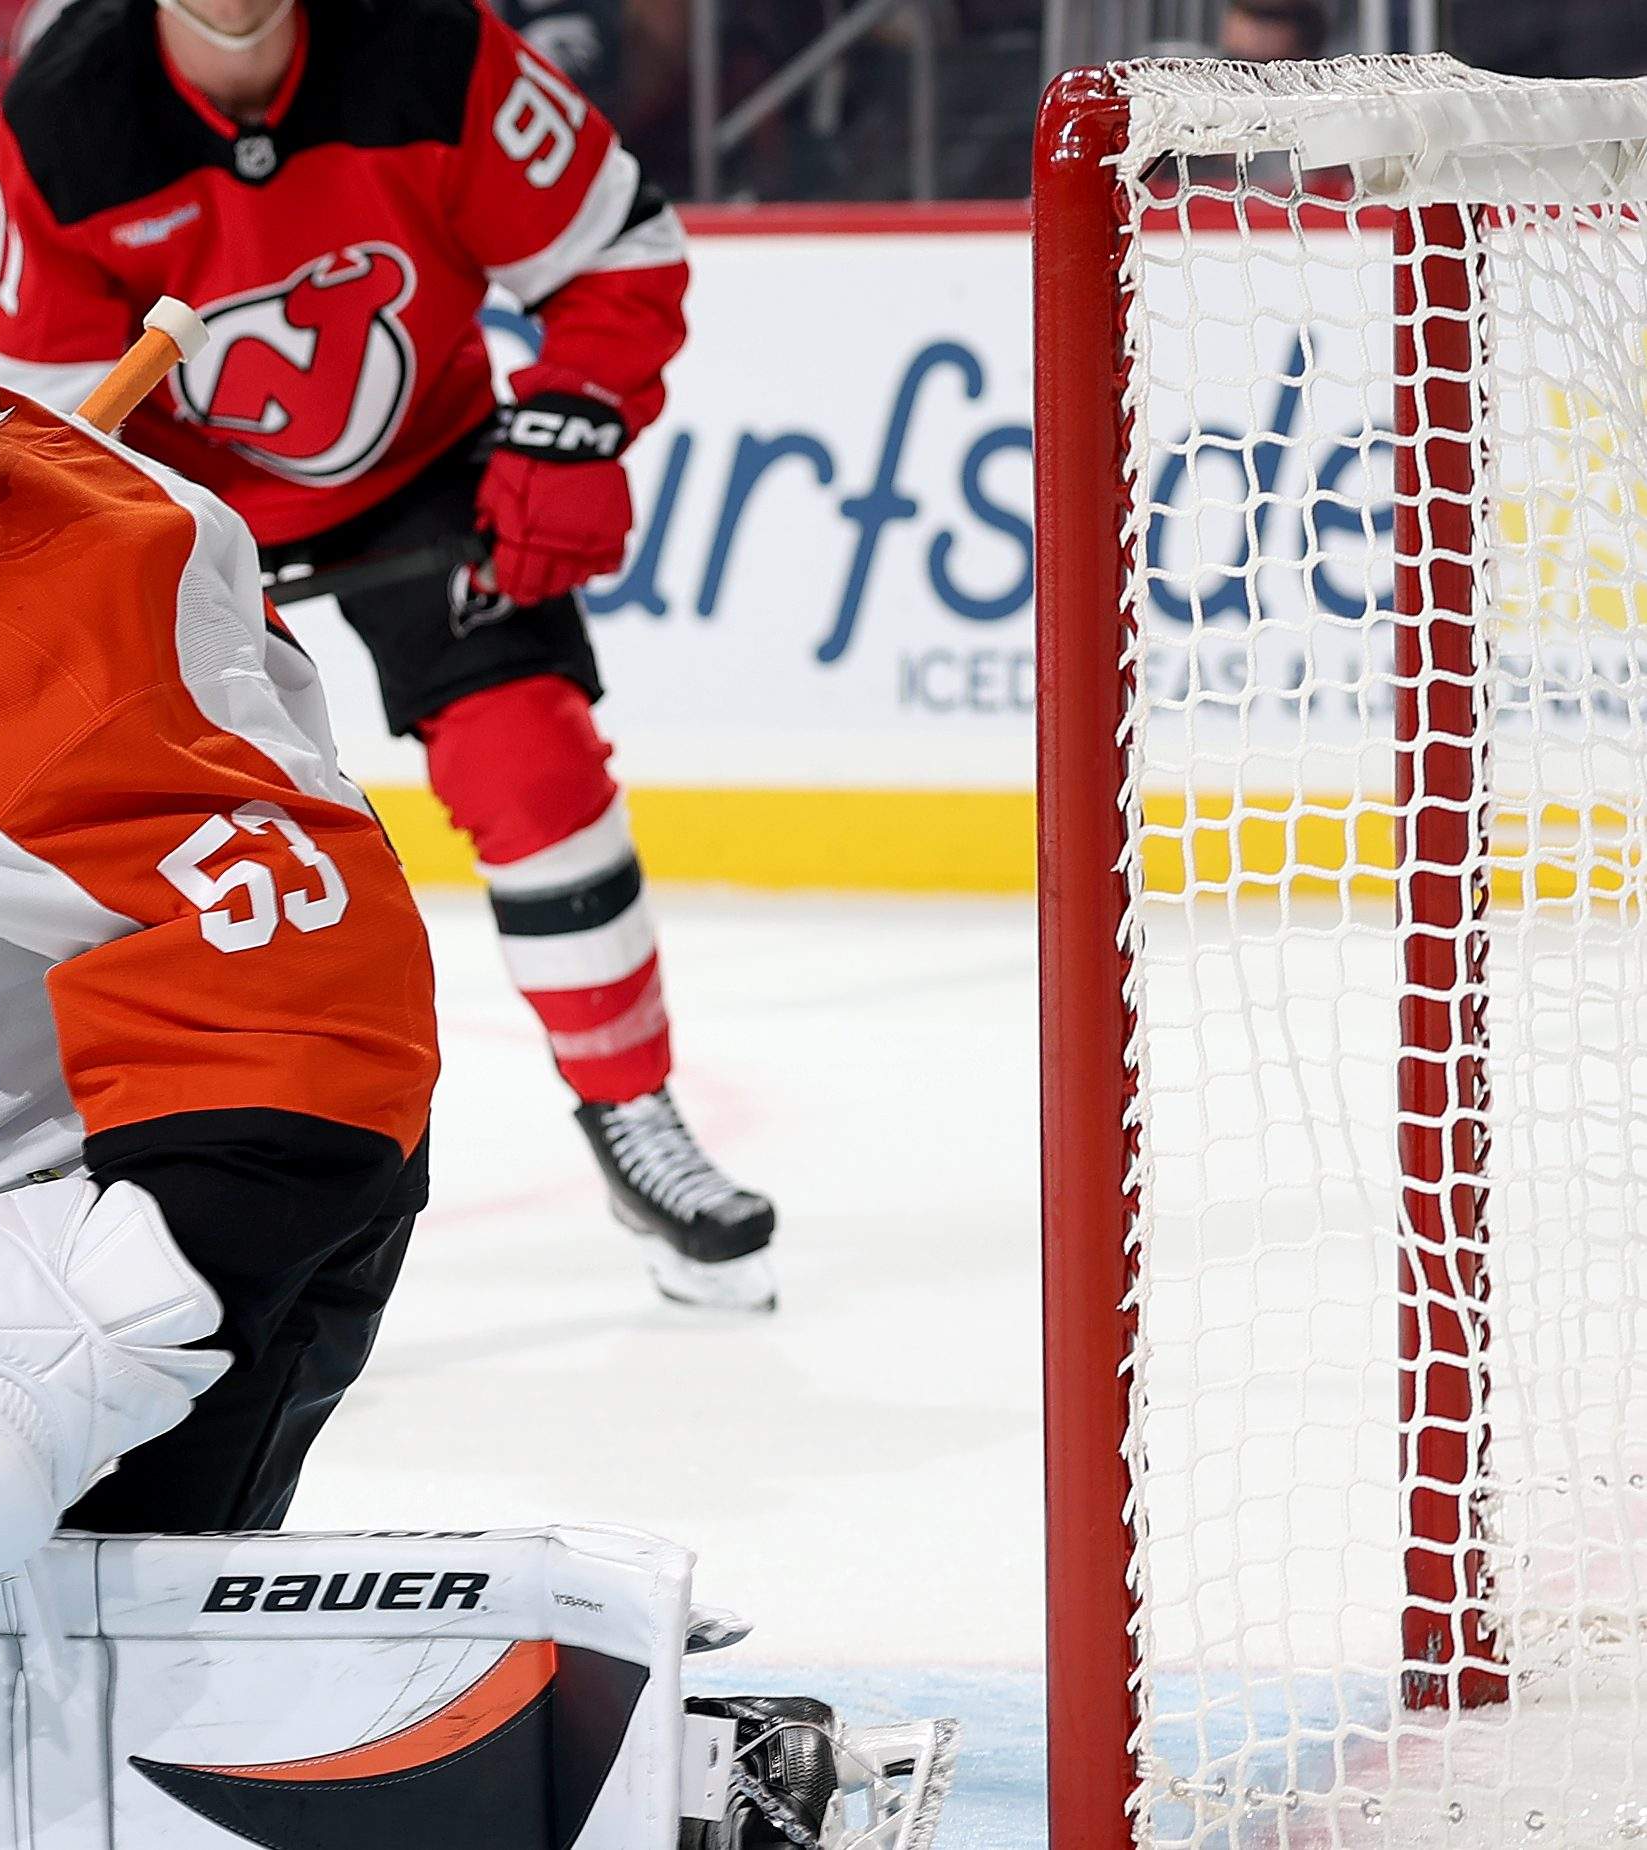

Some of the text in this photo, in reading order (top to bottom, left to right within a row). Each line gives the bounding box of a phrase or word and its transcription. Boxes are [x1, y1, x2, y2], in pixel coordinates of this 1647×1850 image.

[493, 49, 587, 189] 91
[477, 307, 1395, 665] urfsde
[156, 800, 351, 954] 53
